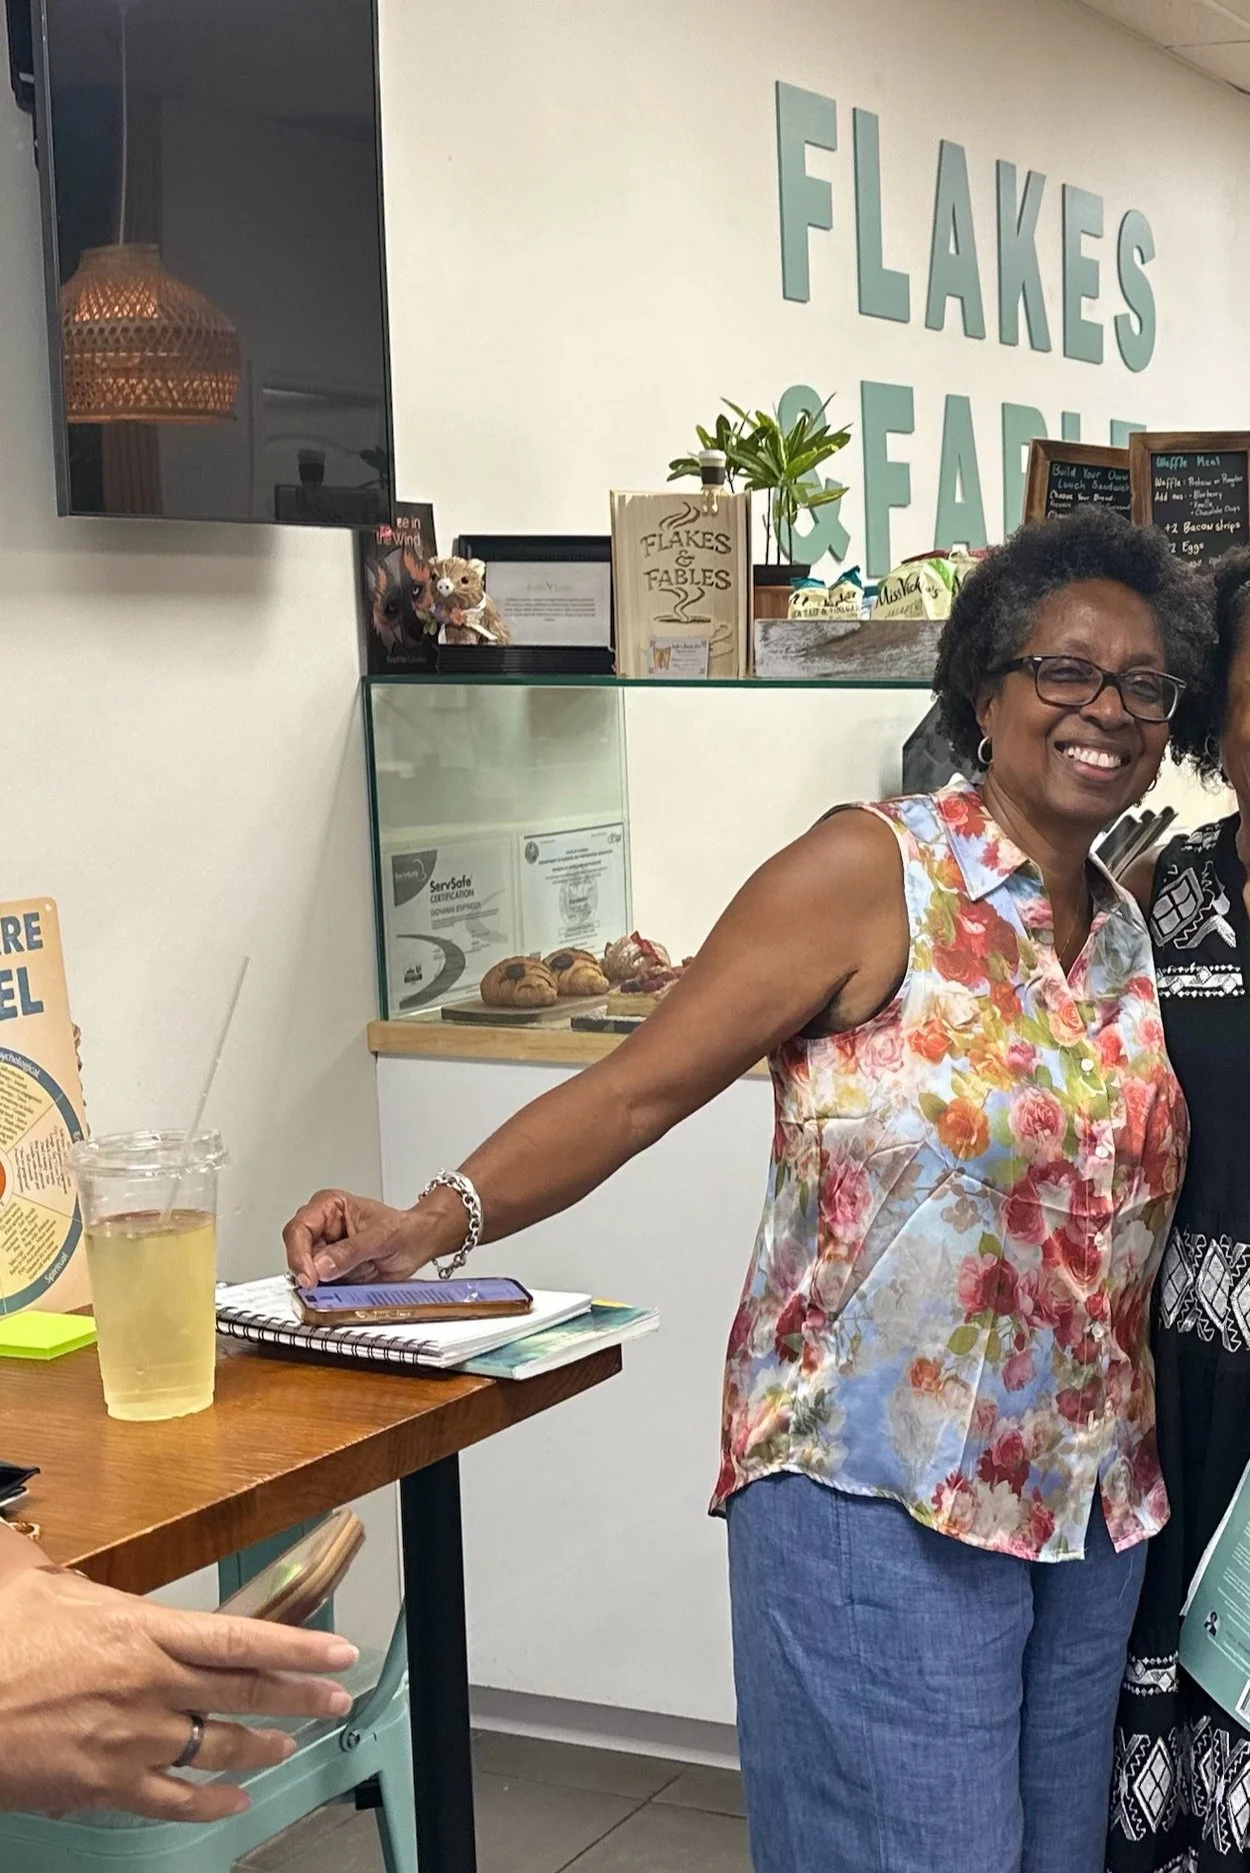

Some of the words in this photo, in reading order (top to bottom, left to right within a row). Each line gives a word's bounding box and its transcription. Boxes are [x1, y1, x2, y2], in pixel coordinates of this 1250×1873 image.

[776, 81, 1155, 373] FLAKES
[1052, 463, 1077, 477] Build
[1083, 468, 1101, 479] Your
[1108, 470, 1128, 481] Own
[1156, 456, 1187, 470] Waffle
[774, 384, 851, 566] &
[1058, 480, 1086, 490] Lunch
[1154, 491, 1168, 501] Add
[1165, 522, 1178, 534] +2
[1183, 521, 1214, 534] Bacon
[392, 531, 421, 547] Wind
[640, 529, 732, 559] FLAKES
[1182, 540, 1204, 555] Eggs
[675, 550, 695, 568] &
[643, 568, 732, 591] FABLES
[430, 875, 472, 893] ServSafe
[430, 889, 475, 904] CERTIFICATION
[0, 911, 44, 955] RE
[0, 1050, 40, 1078] ychological
[44, 1252, 69, 1284] Spiritual
